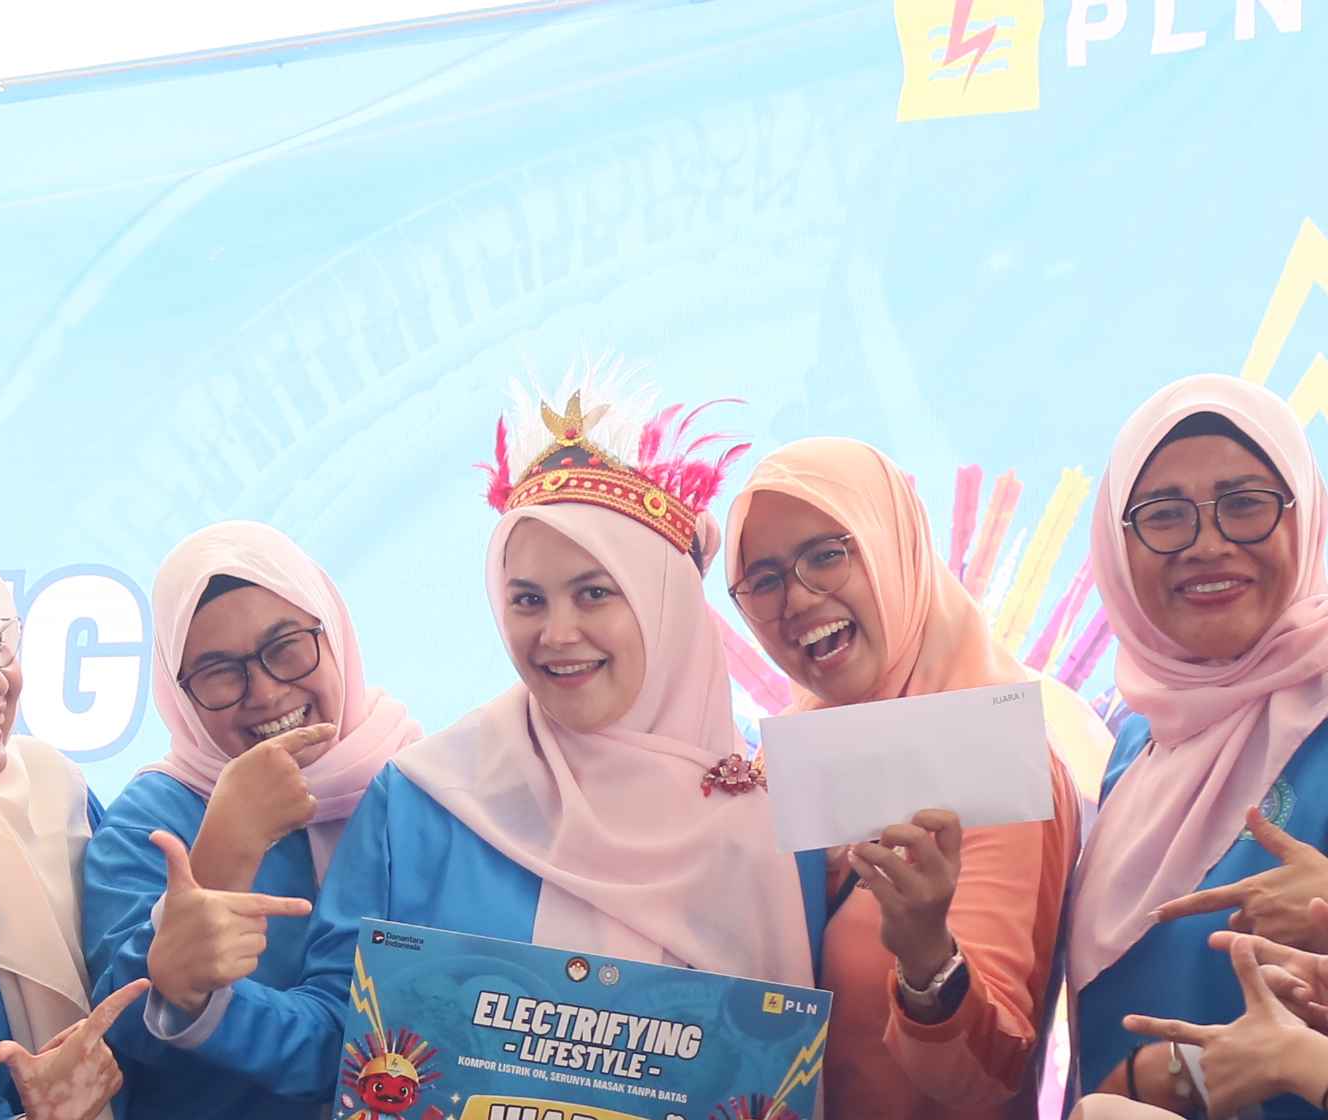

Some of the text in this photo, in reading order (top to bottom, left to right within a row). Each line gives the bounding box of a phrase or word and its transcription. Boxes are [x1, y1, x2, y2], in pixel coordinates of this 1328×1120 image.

[1065, 0, 1304, 68] PLN
[472, 991, 703, 1060] ELECTRIFYING
[785, 1000, 818, 1015] PLN
[458, 1056, 687, 1104] KOMPOR LISTRIK ON, SERUNYA MASAK TANPA BATAS
